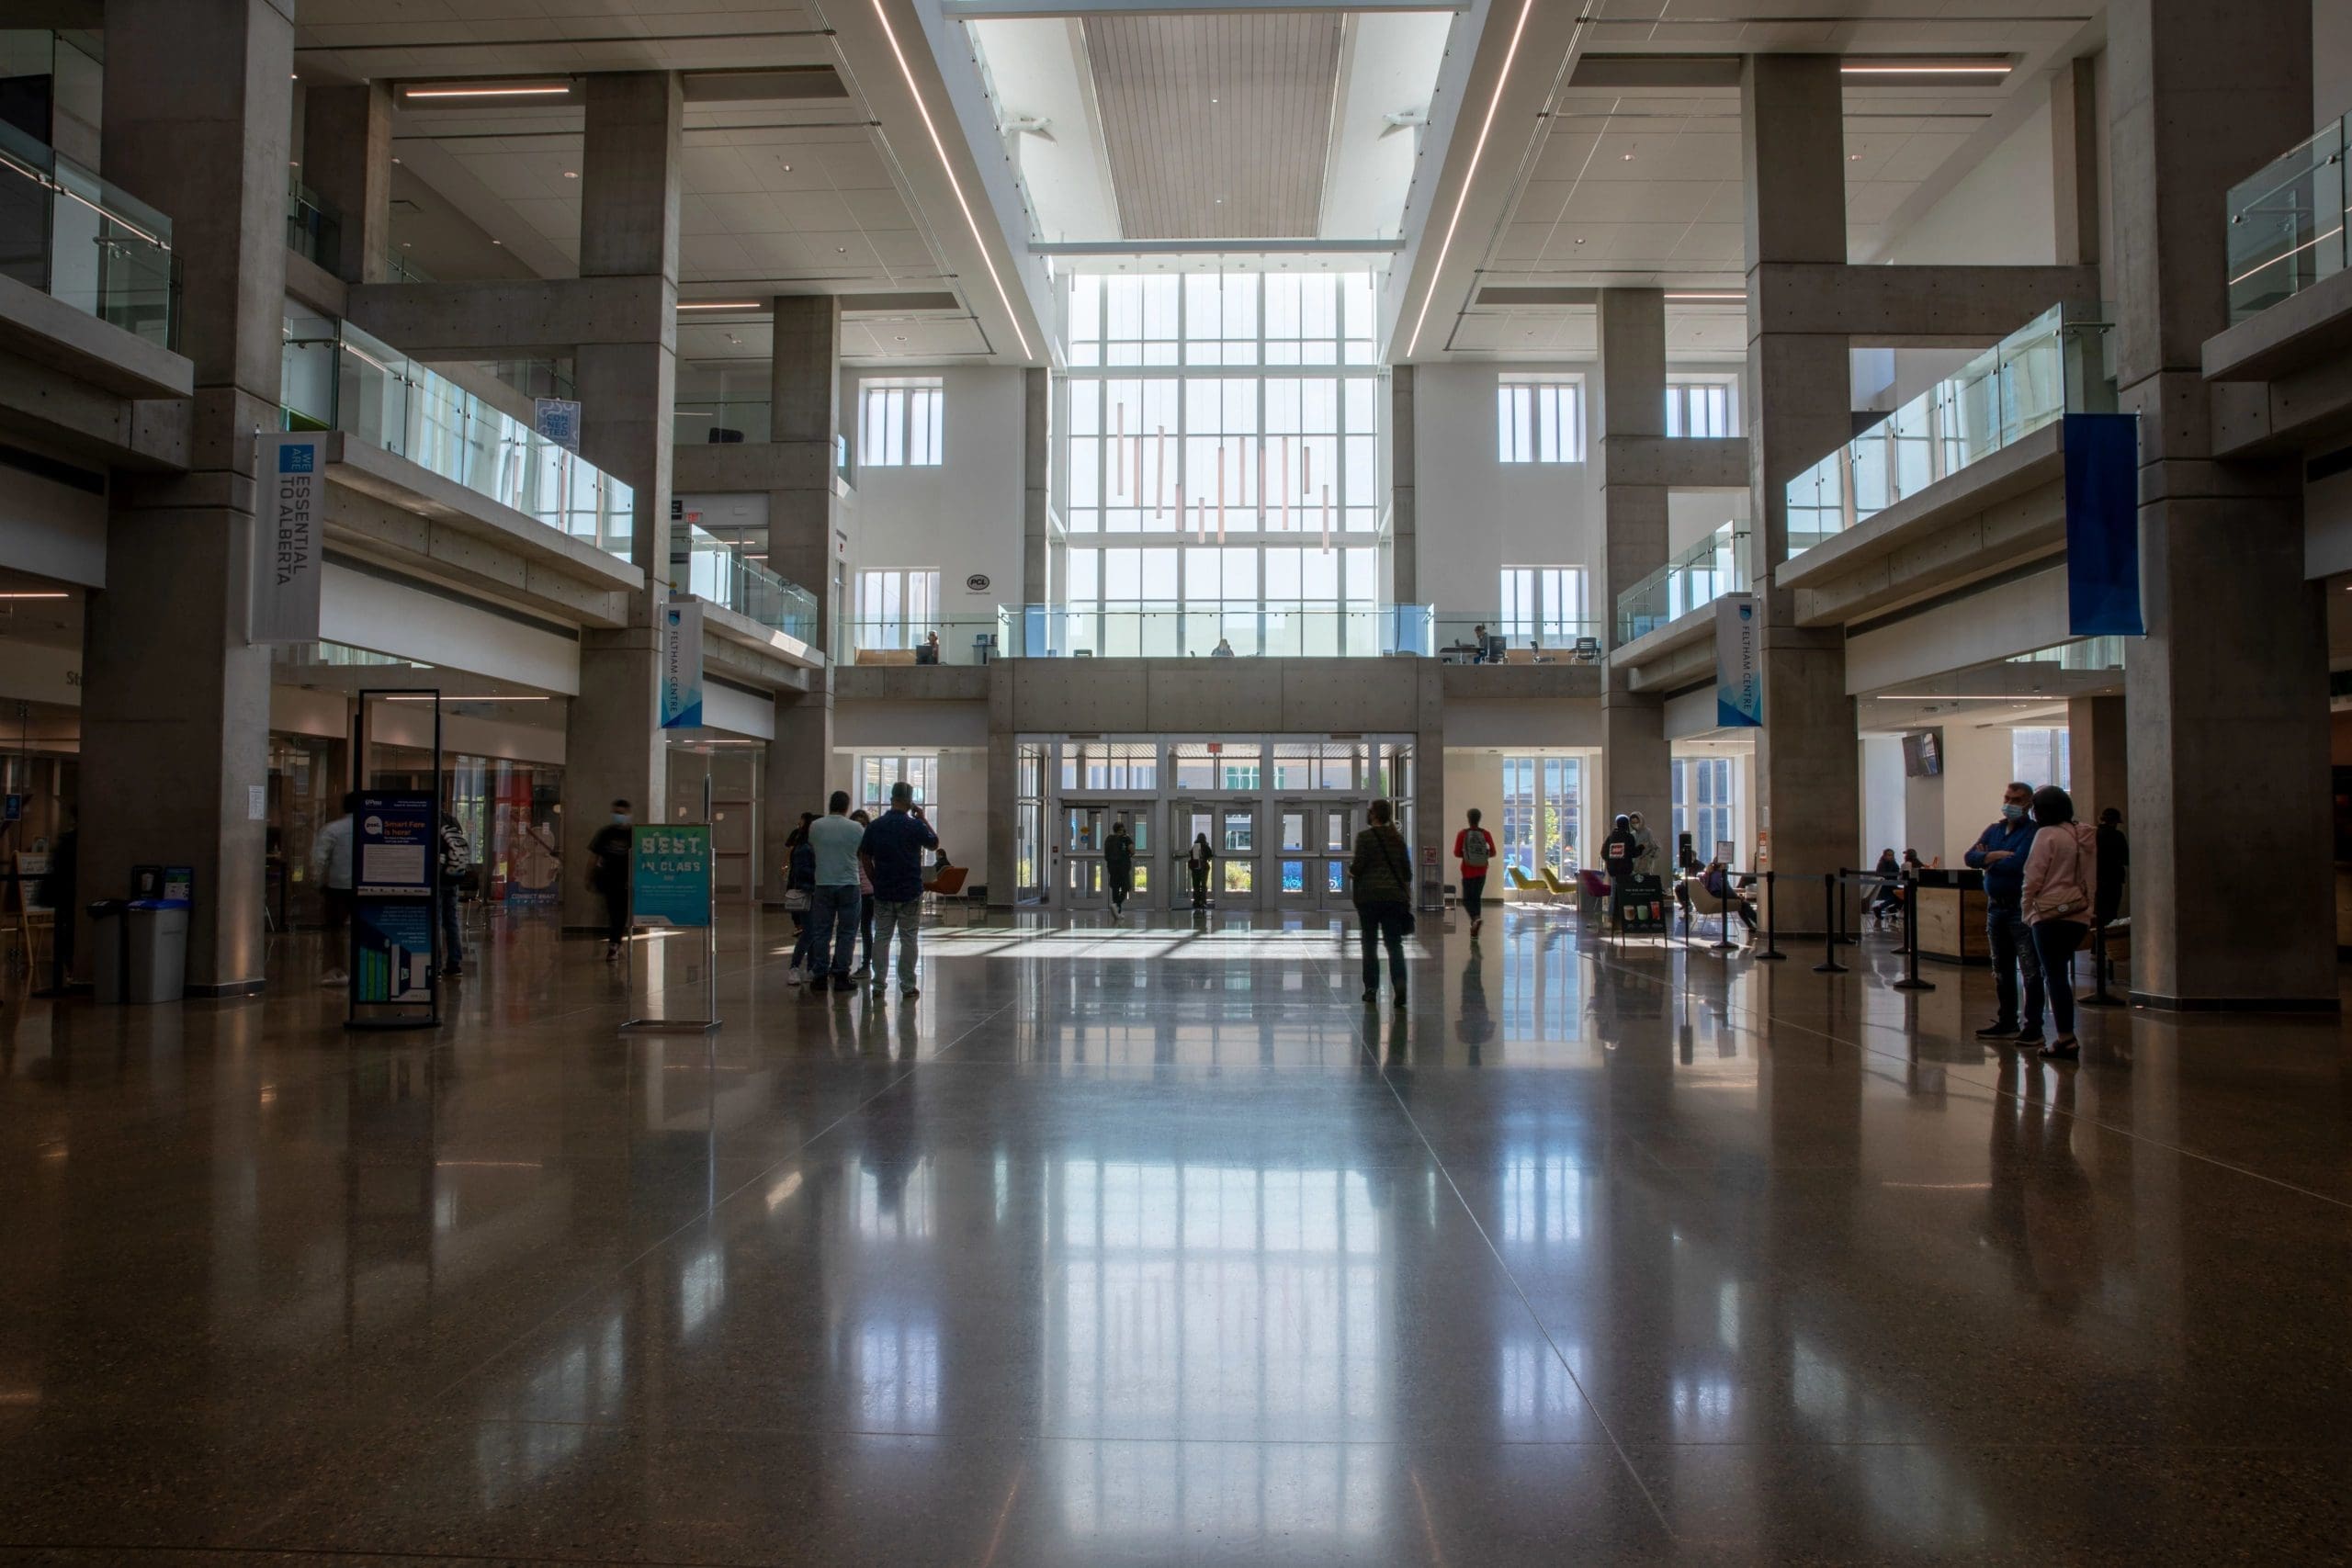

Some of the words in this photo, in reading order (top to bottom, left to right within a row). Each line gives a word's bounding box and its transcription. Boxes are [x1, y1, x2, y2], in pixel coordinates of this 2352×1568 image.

[290, 447, 301, 471] ARE
[300, 452, 312, 471] WE
[279, 476, 295, 500] TO
[292, 476, 311, 575] ESSENTIAL
[277, 504, 293, 586] ALBERTA
[670, 631, 678, 673] FELTHAM
[1742, 626, 1751, 670] FELTHAM
[670, 676, 678, 712] CENTRE
[1742, 672, 1752, 711] CENTRE
[661, 861, 701, 873] CLASS
